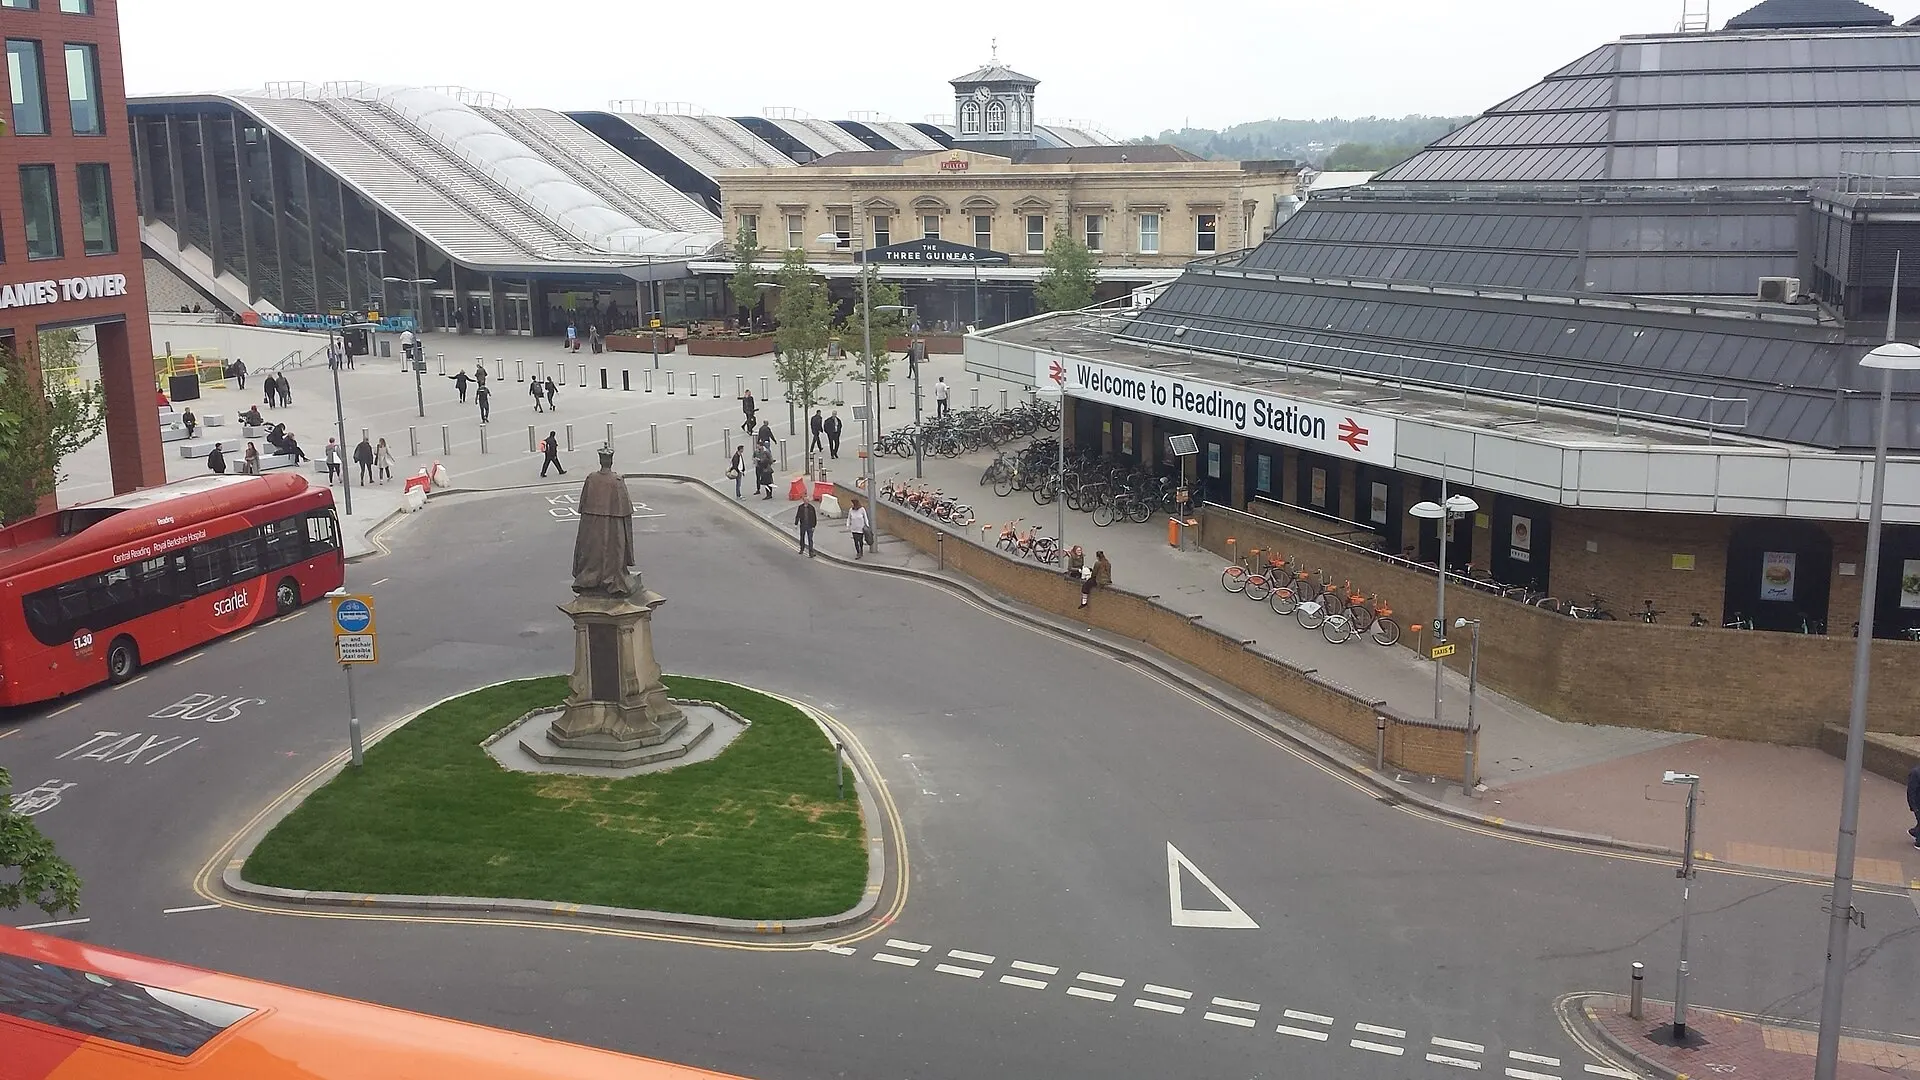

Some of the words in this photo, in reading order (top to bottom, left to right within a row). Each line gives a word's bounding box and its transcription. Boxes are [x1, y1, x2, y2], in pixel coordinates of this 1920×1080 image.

[886, 252, 921, 260] THREE
[926, 252, 975, 261] GUINEAS
[0, 280, 58, 309] AMES
[59, 274, 127, 301] TOWER
[1077, 364, 1146, 401] Welcome
[1150, 380, 1166, 405] to
[1172, 383, 1246, 430] Reading
[1253, 399, 1326, 440] Station
[156, 516, 175, 526] Reading
[113, 550, 131, 563] Central
[130, 544, 151, 557] Reading
[153, 541, 167, 553] Royal
[166, 534, 188, 548] Berkshire
[188, 529, 207, 542] Hospital
[213, 587, 248, 617] scarlet
[1434, 648, 1448, 656] TAXIS
[148, 693, 266, 723] BUS
[55, 731, 200, 765] TAXI
